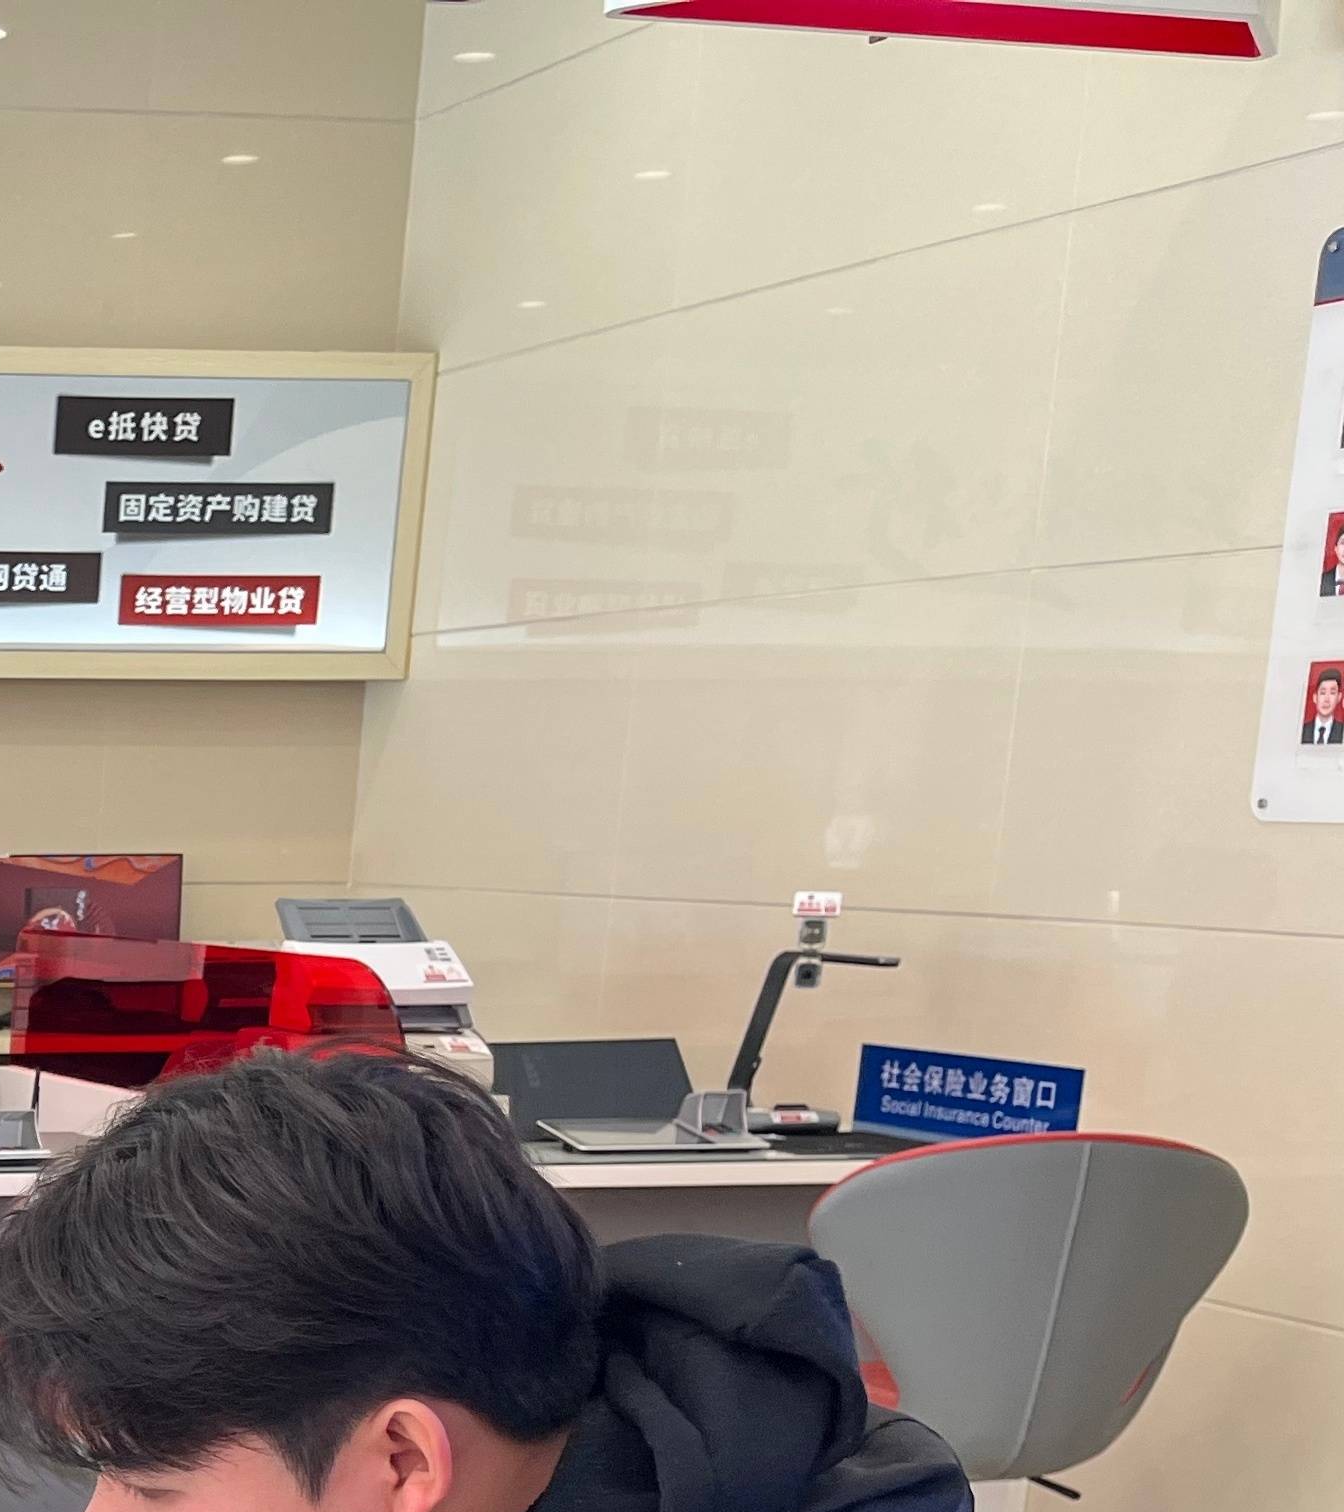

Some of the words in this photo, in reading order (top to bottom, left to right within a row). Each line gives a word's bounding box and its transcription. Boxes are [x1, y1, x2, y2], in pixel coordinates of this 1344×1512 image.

[88, 411, 202, 444] e抵快贷
[118, 493, 317, 524] 固定资产购建贷
[134, 586, 306, 616] 经营型物业贷
[880, 1059, 1057, 1110] 社会保险业务窗口
[880, 1095, 922, 1117] Social
[923, 1101, 989, 1128] Insurance
[992, 1110, 1051, 1133] Counter
